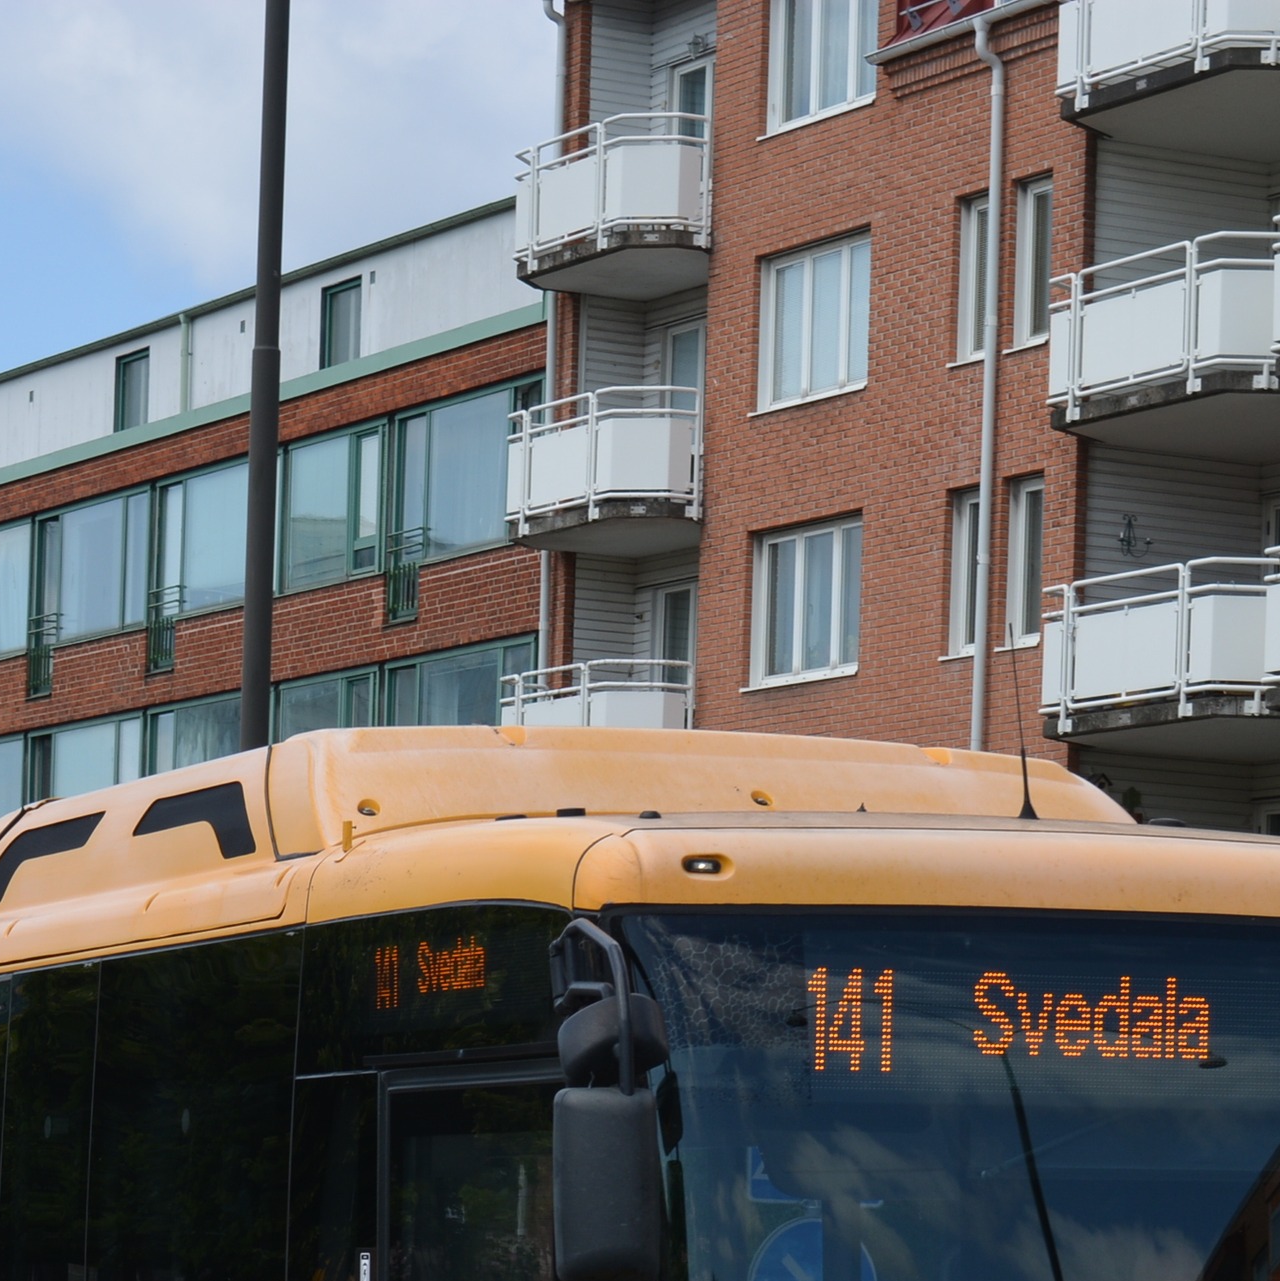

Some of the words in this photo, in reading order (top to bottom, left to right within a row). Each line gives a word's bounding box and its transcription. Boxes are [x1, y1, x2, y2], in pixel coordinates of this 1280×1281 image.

[375, 945, 398, 1010] 141
[417, 936, 485, 993] Svedala
[807, 967, 894, 1072] 141
[973, 972, 1210, 1060] Svedala
